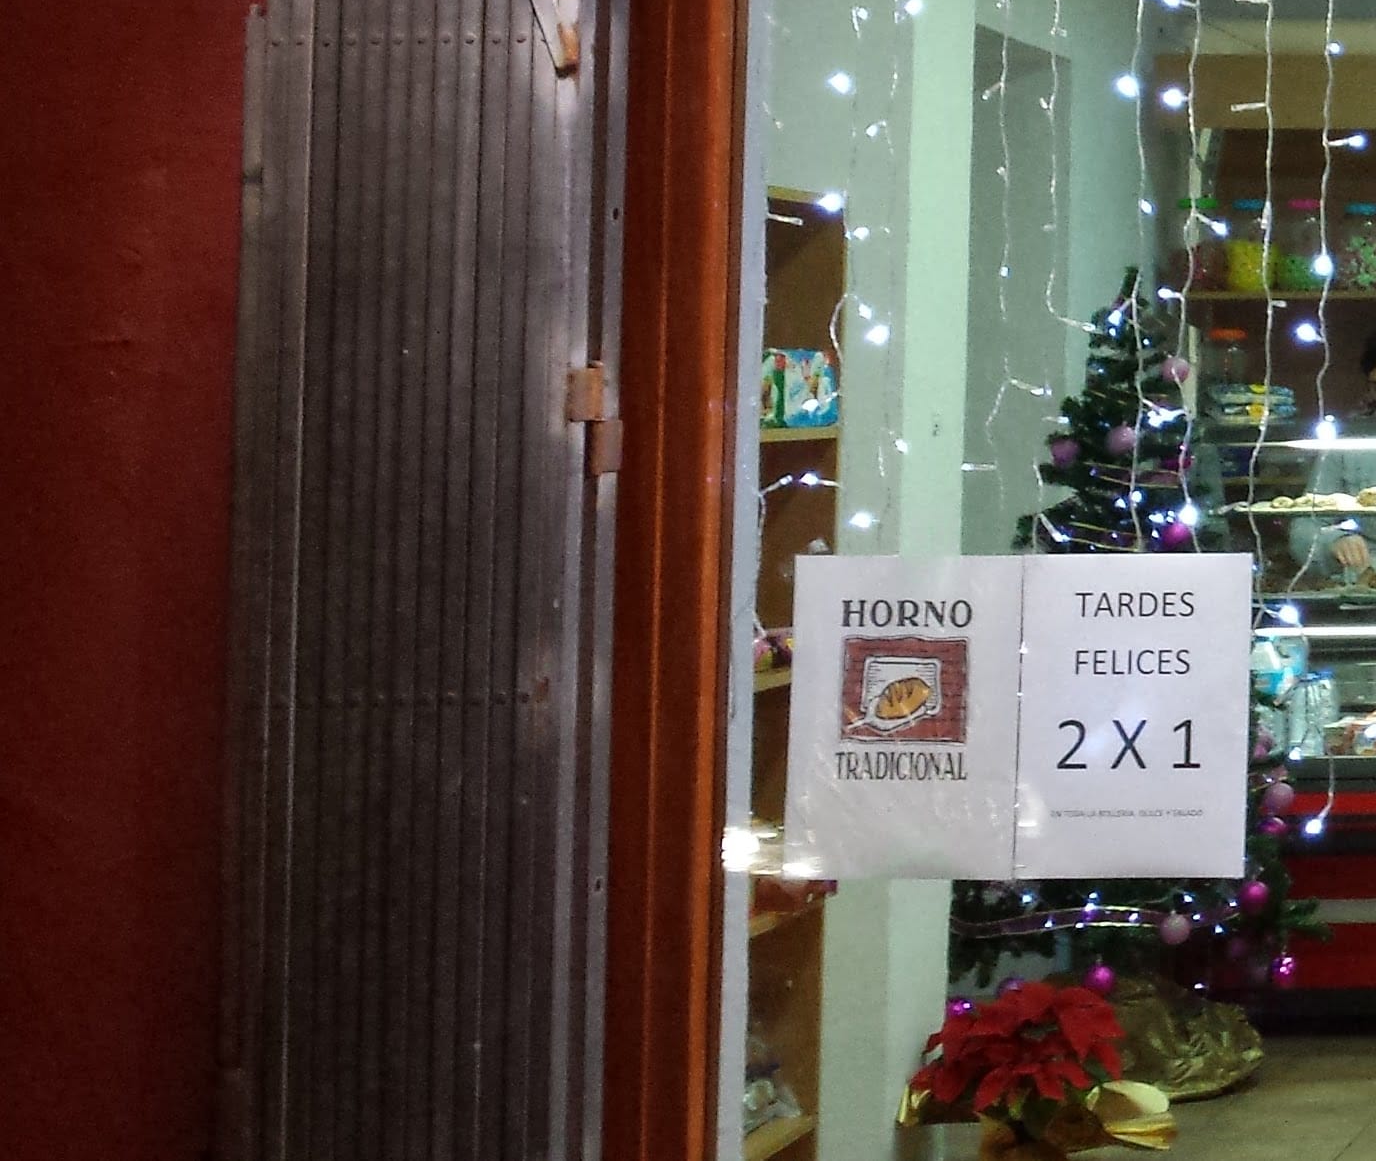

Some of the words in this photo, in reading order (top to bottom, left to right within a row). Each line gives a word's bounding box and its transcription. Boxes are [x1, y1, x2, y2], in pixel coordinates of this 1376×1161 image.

[841, 600, 972, 628] HORNO
[1075, 591, 1195, 617] TARDES
[1075, 649, 1191, 675] FELICES
[1056, 719, 1088, 770] 2
[1110, 719, 1147, 770] X
[1172, 719, 1201, 769] 1
[835, 751, 967, 780] TRADICIONAL
